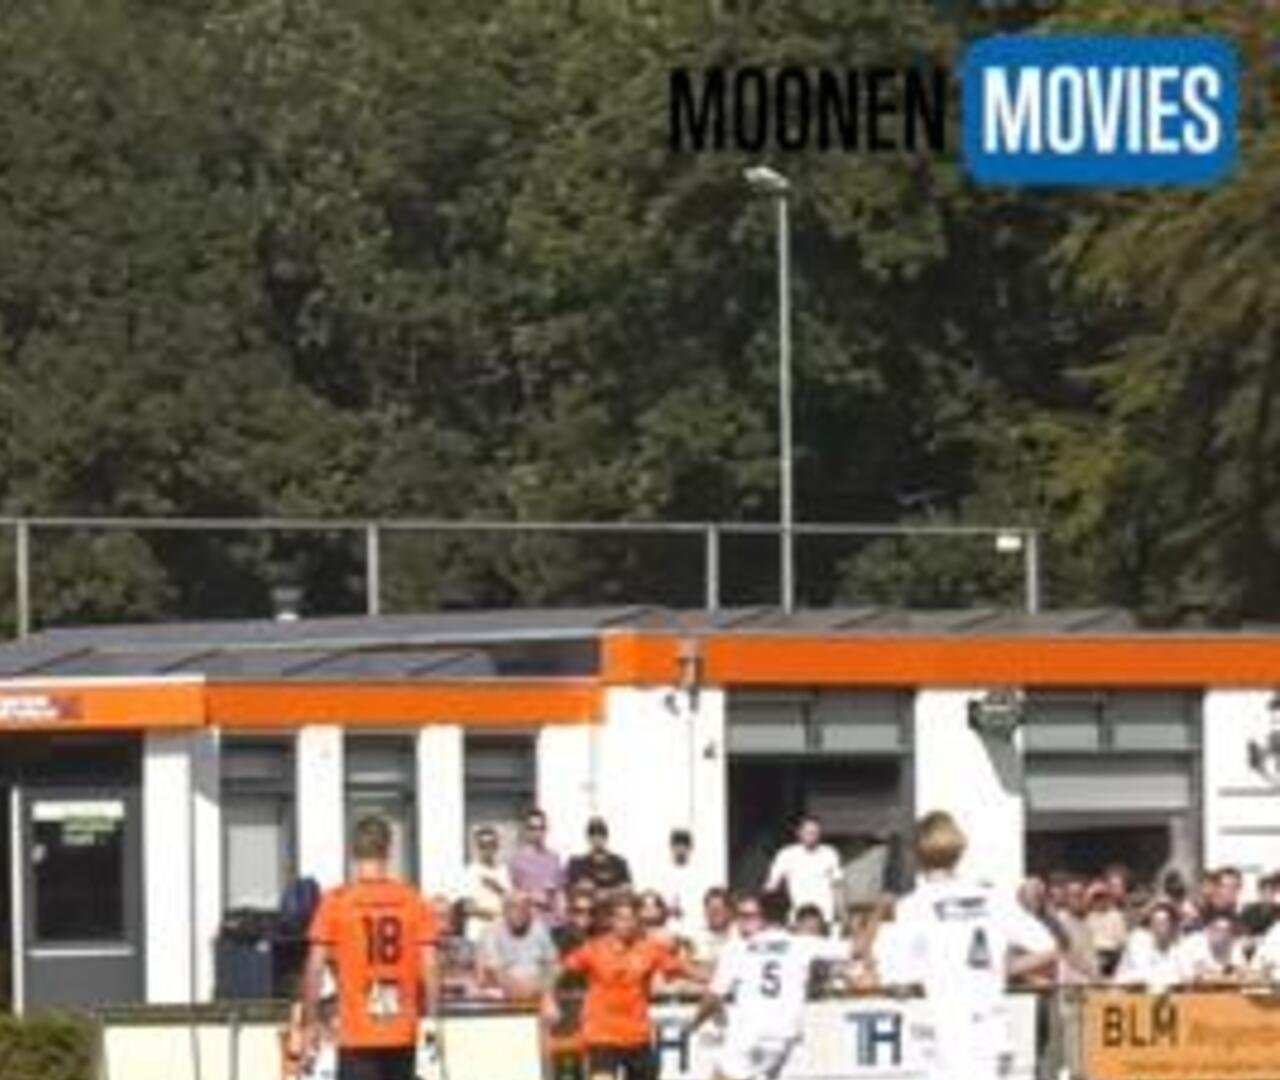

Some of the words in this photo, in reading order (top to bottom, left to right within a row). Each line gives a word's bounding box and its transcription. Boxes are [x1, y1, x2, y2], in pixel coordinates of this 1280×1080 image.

[361, 915, 403, 966] 18
[965, 926, 993, 970] 4
[760, 960, 782, 999] 5
[1102, 1001, 1179, 1047] BLM
